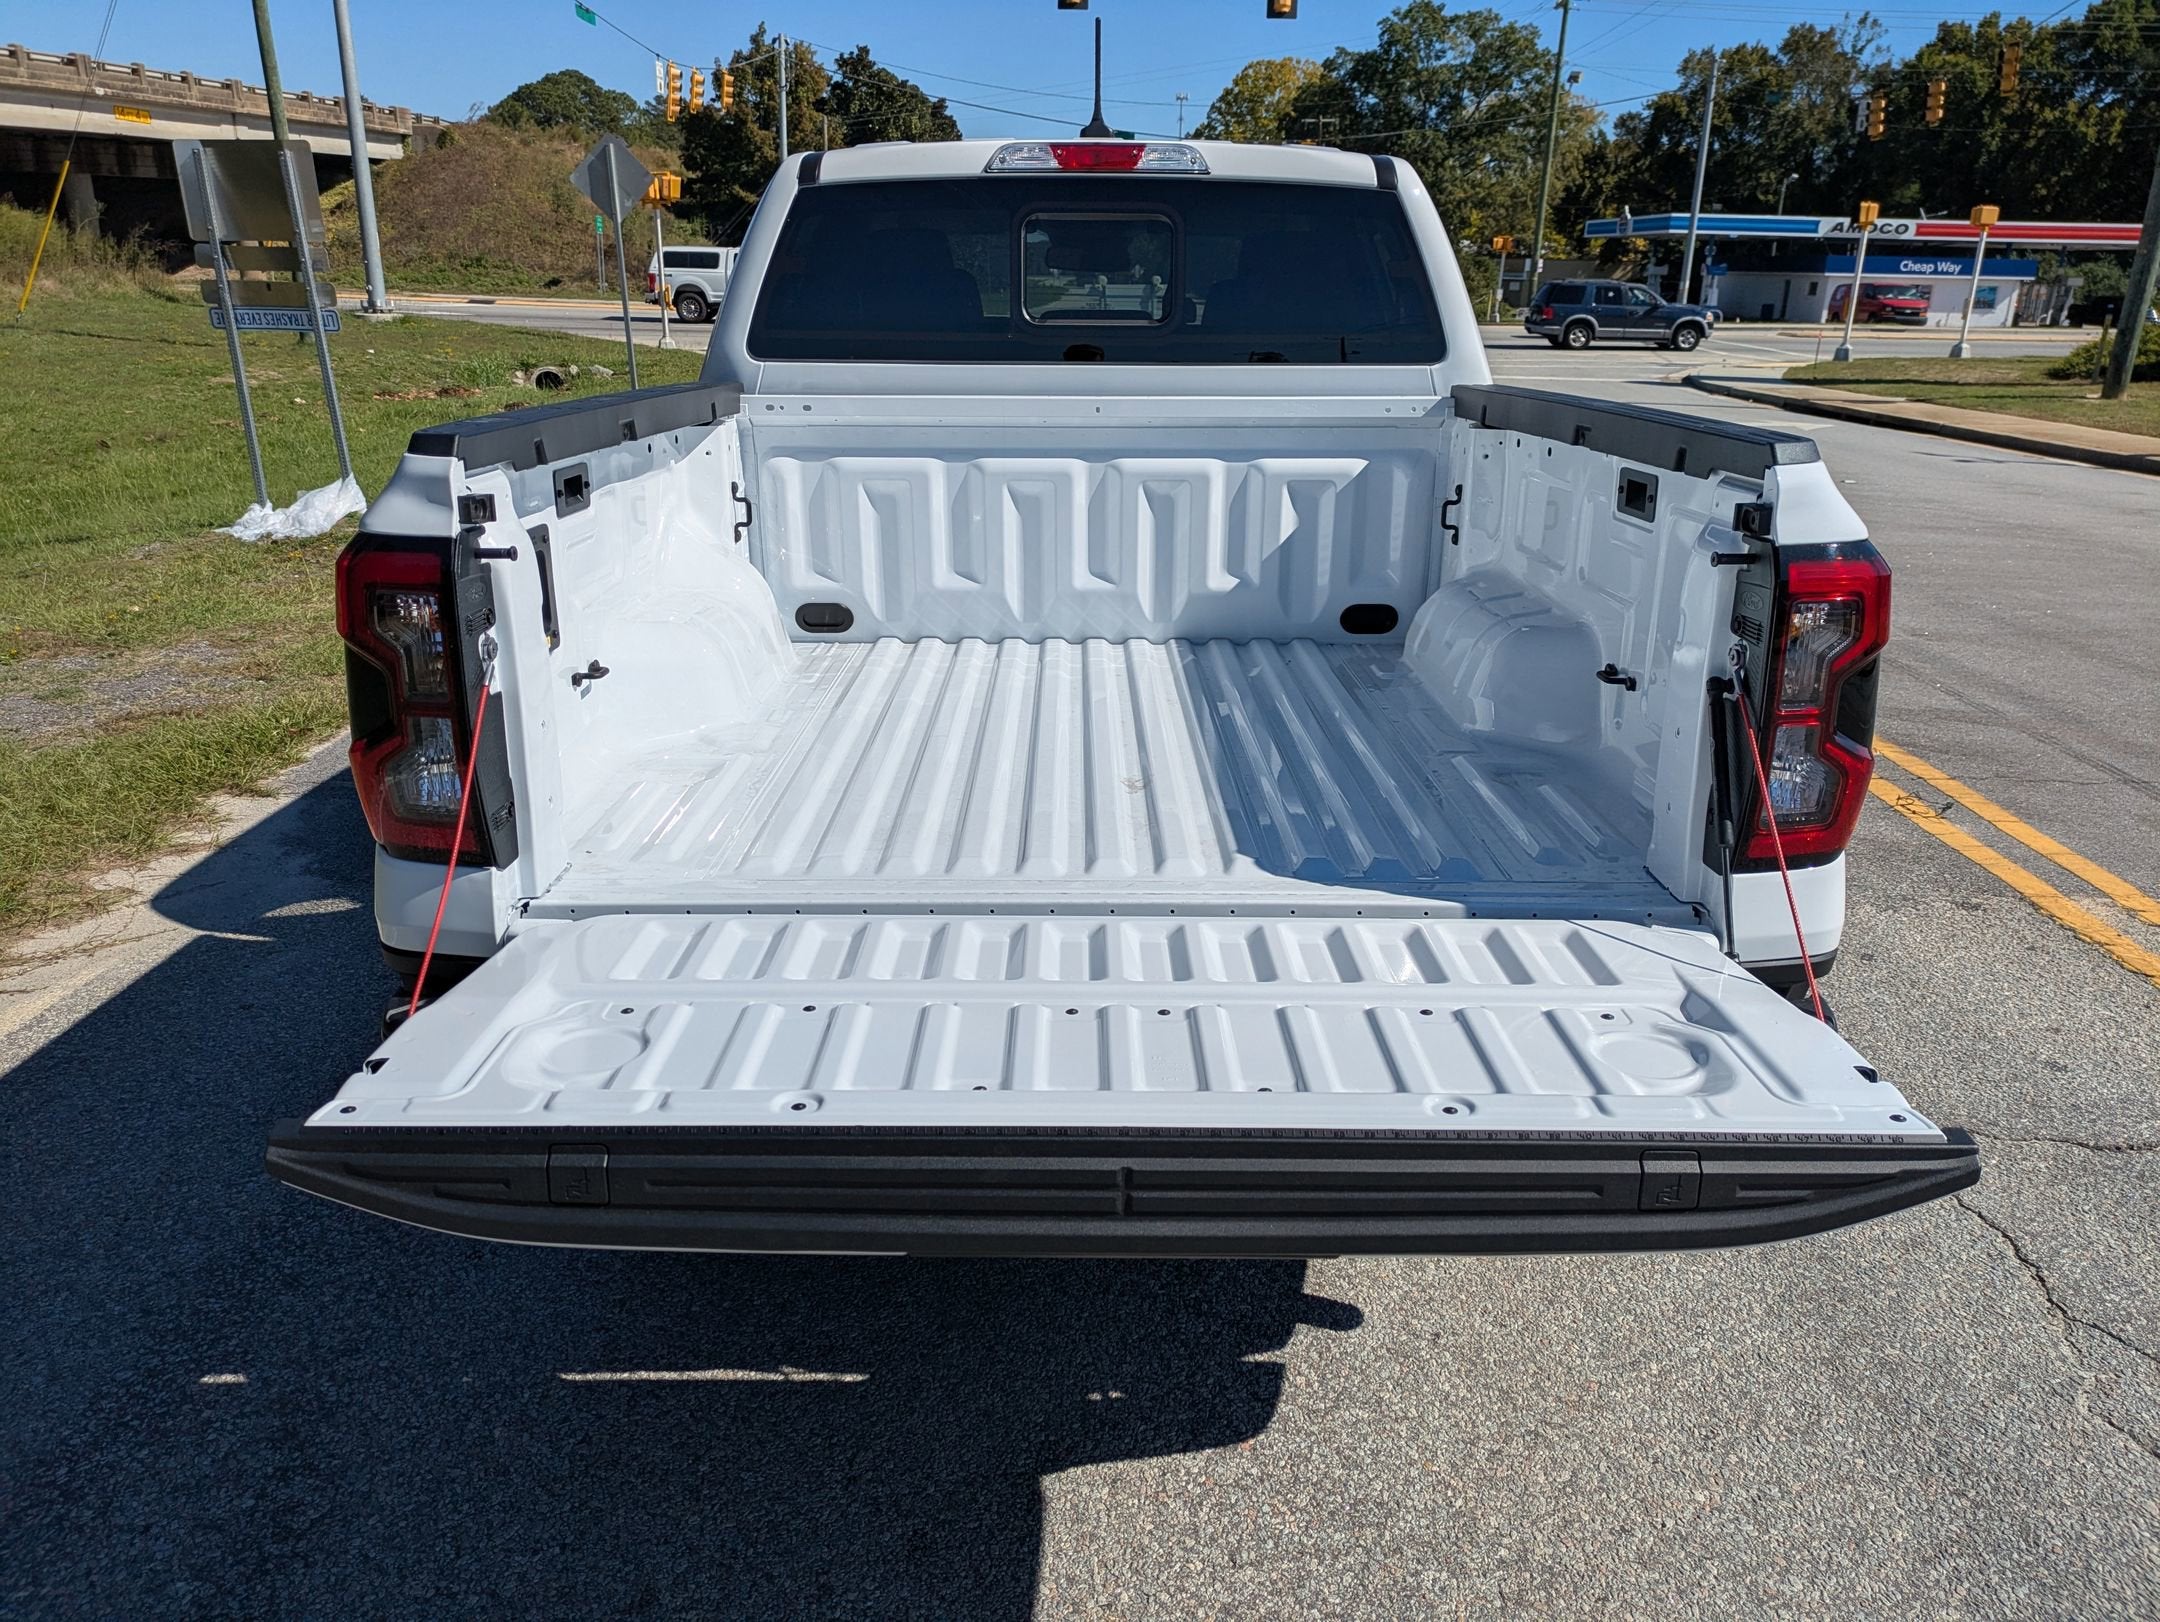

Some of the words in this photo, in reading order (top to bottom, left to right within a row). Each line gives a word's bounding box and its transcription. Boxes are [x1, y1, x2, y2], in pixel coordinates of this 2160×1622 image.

[1900, 260, 1934, 275] Cheap
[1937, 261, 1963, 275] Way
[263, 312, 304, 327] TRASHES
